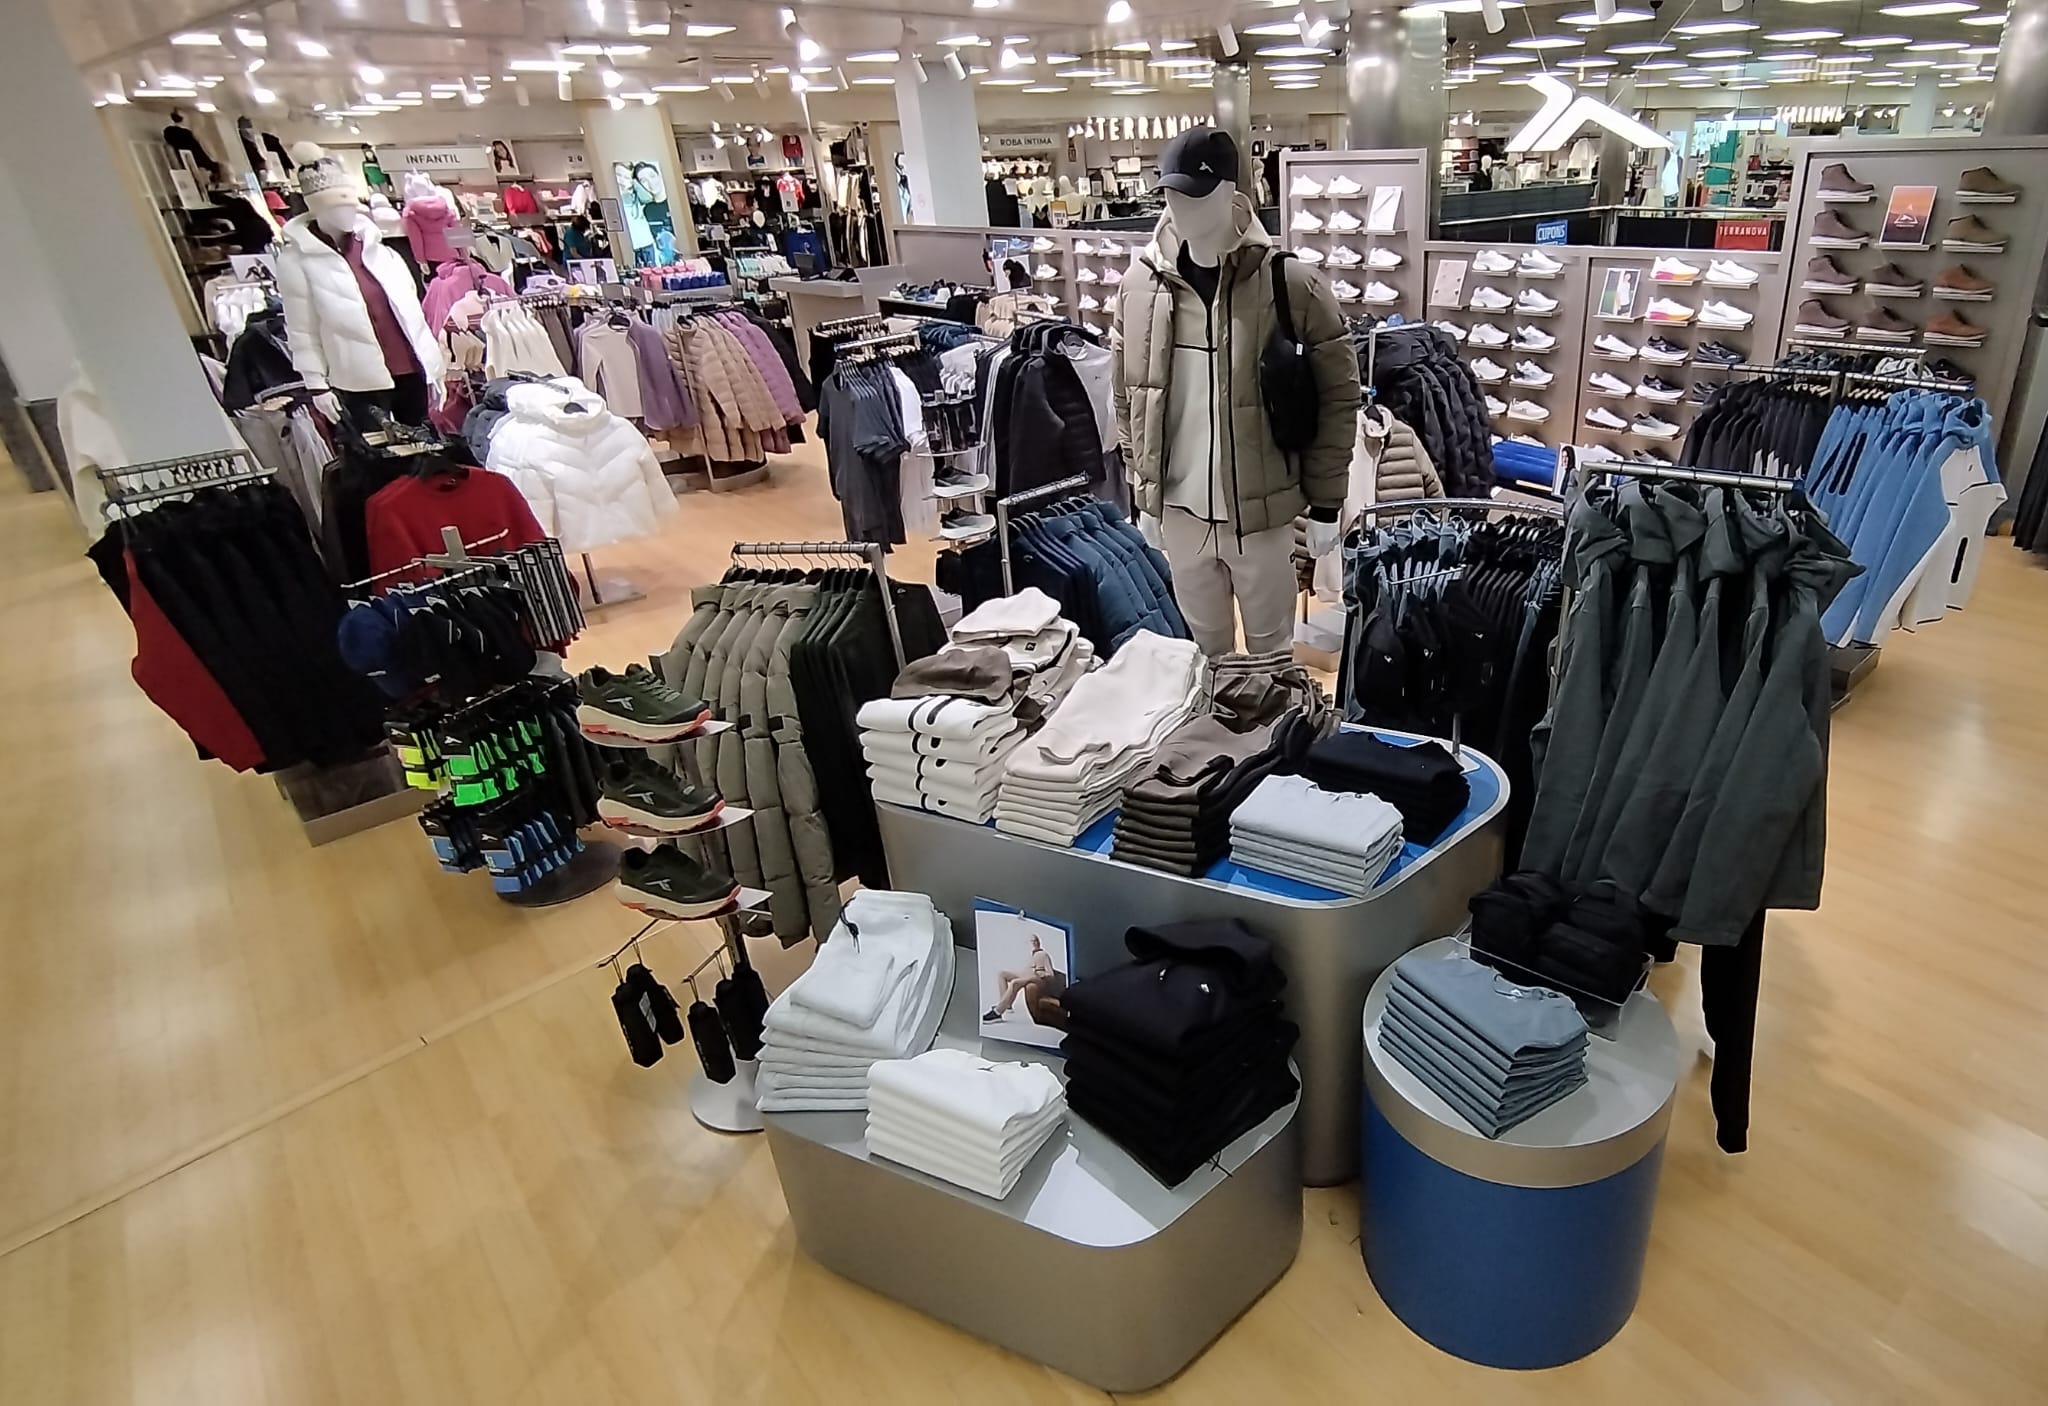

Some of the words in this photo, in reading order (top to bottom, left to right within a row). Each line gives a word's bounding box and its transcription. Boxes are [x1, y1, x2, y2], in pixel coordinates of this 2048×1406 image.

[405, 153, 460, 164] INFANTIL
[1537, 224, 1566, 241] CUPONS
[1719, 225, 1768, 236] TERRANOVA
